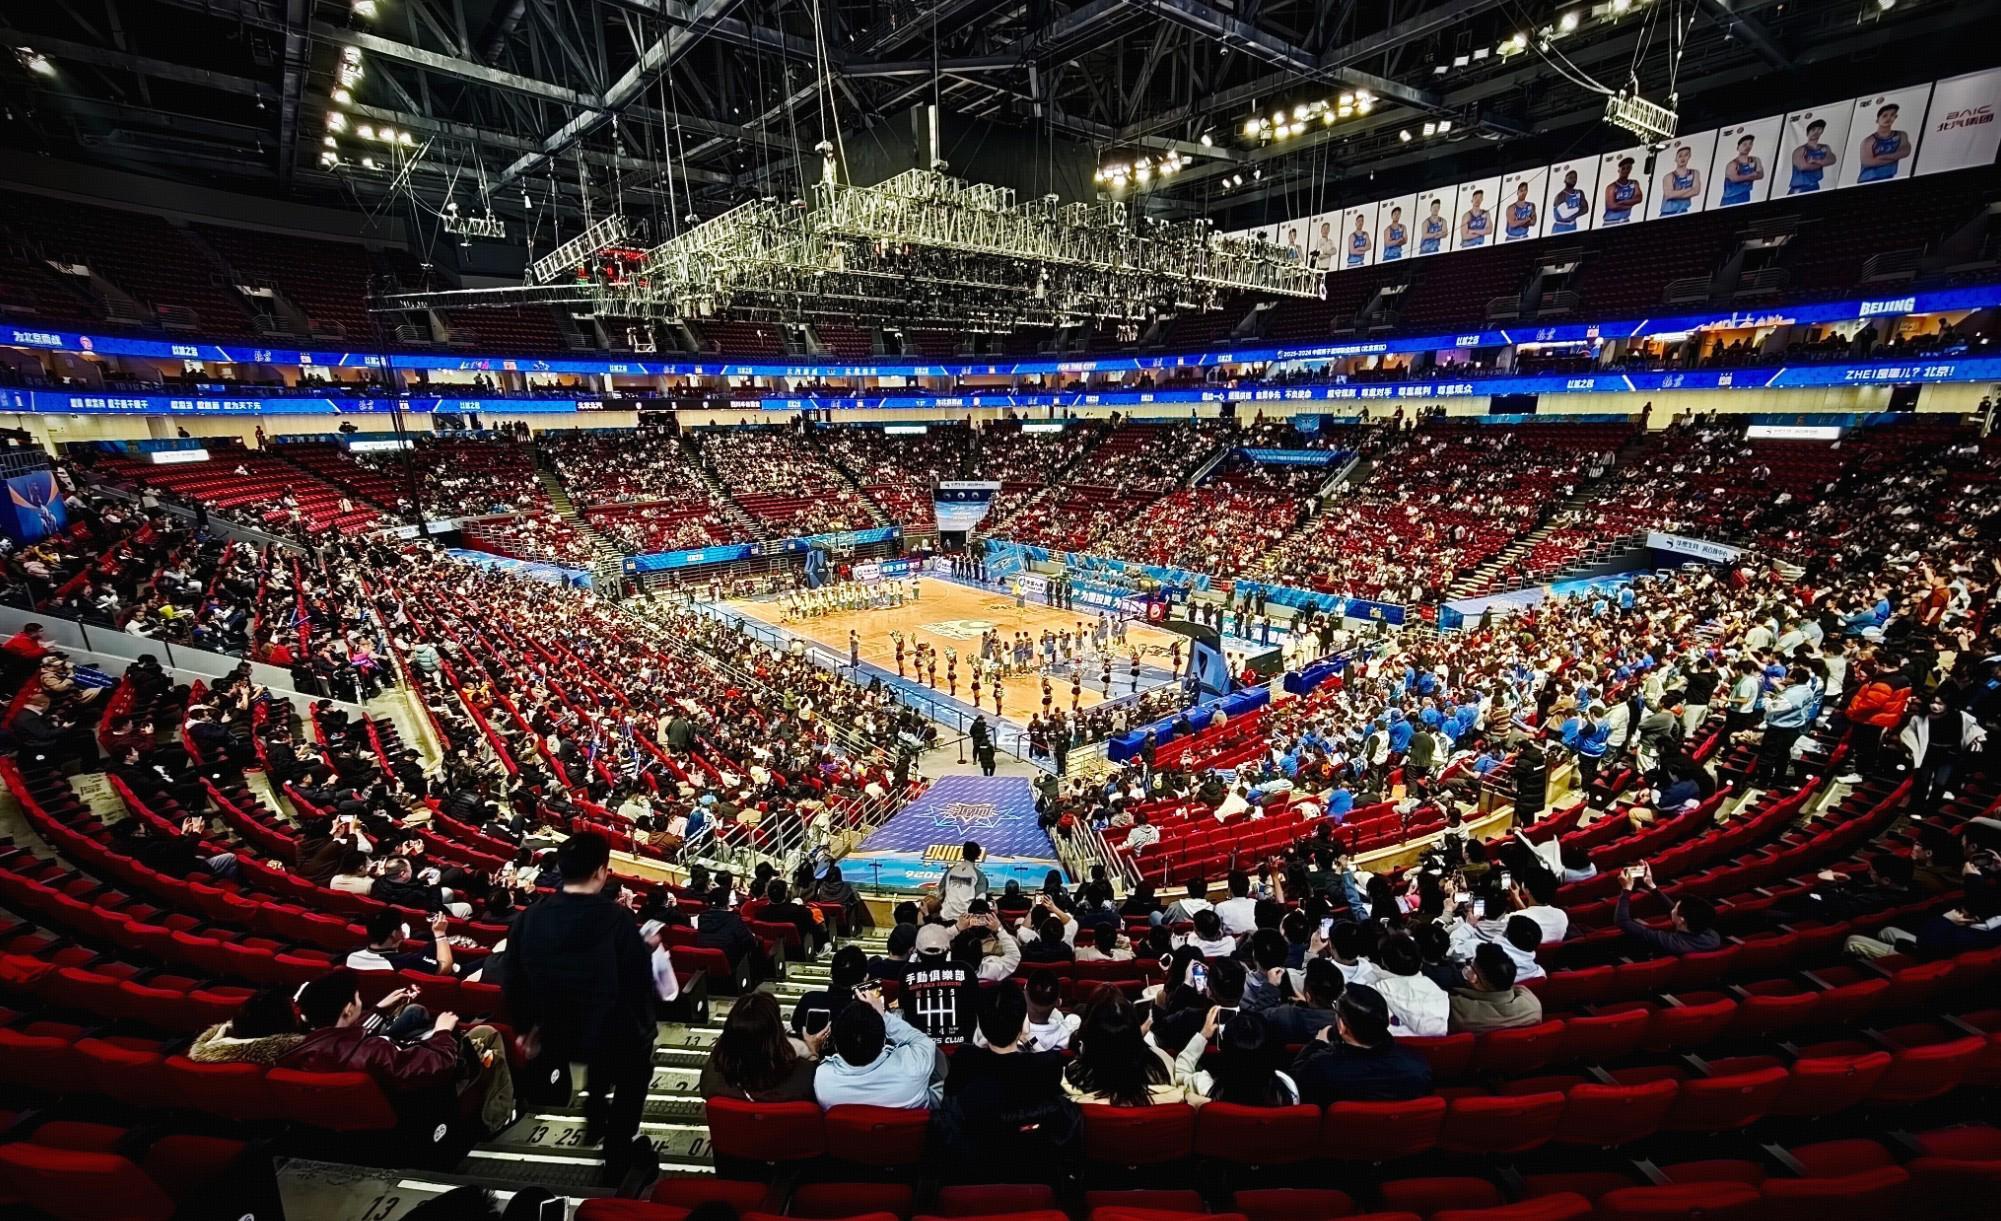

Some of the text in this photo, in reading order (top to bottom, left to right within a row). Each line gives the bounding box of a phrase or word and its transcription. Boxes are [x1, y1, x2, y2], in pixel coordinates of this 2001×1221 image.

[1936, 112, 1995, 132] 北汽集团
[1858, 297, 1916, 317] BEIJING
[905, 969, 966, 985] 手動俱樂部
[938, 989, 944, 997] 3
[950, 988, 955, 996] 5
[945, 1036, 965, 1044] CLUB
[526, 1126, 583, 1146] 13 25
[361, 1197, 399, 1221] 13
